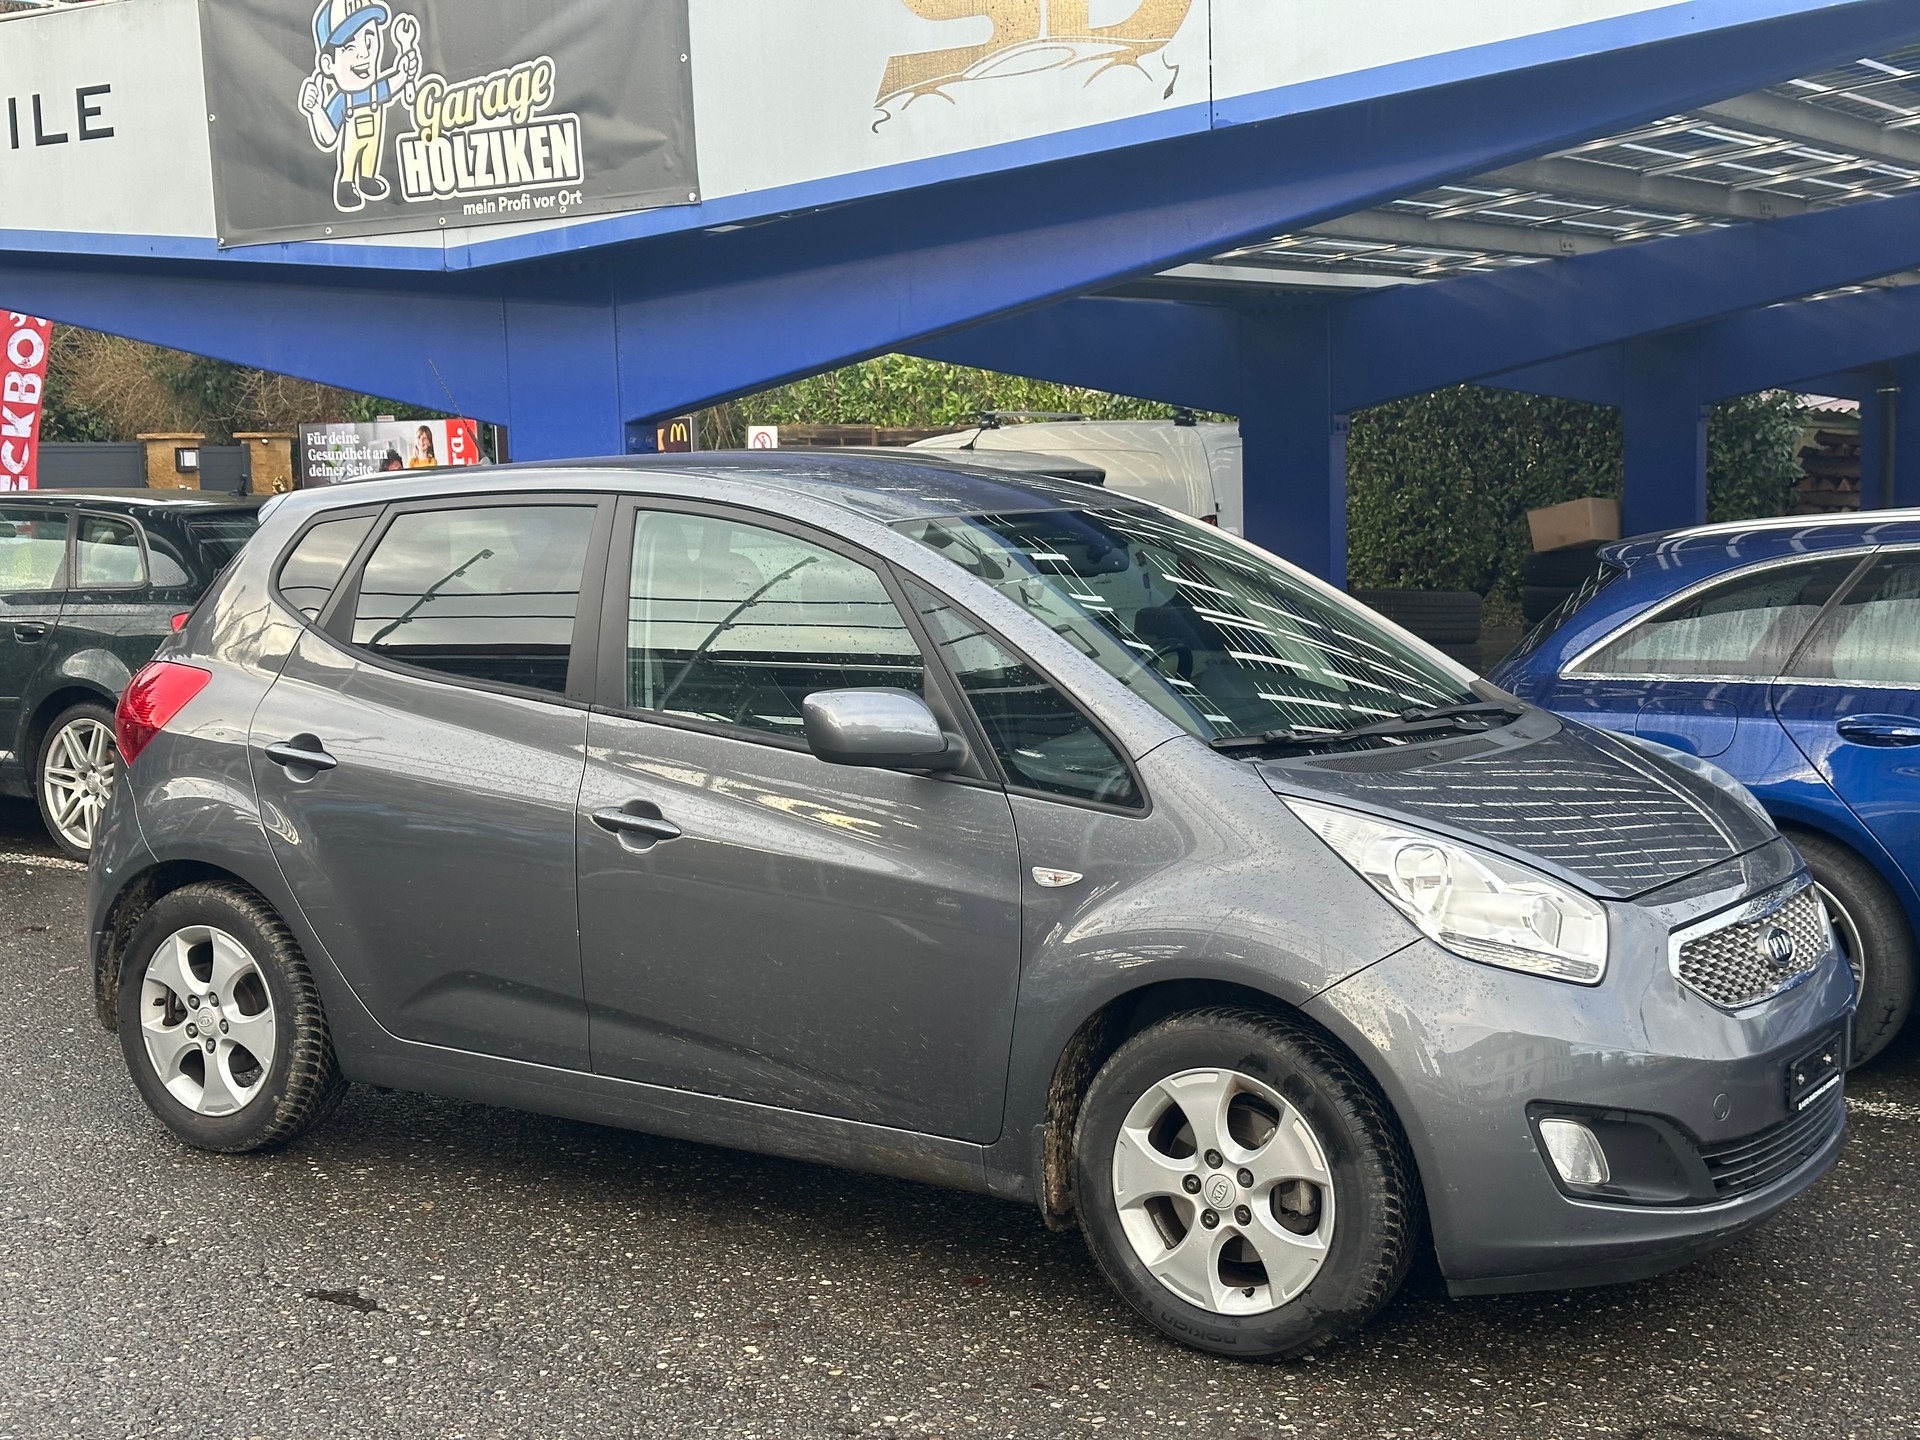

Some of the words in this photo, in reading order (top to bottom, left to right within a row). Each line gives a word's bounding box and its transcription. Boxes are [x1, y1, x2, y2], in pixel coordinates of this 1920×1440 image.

[8, 83, 115, 150] ILE
[415, 64, 550, 146] Garage
[401, 121, 578, 194] HOLZIKEN
[463, 198, 496, 215] mein
[498, 193, 531, 212] Profi
[533, 194, 556, 208] vor
[558, 189, 583, 206] Ort
[306, 432, 327, 446] Für
[329, 431, 360, 445] deine
[307, 446, 372, 461] Gesundheit
[372, 449, 389, 460] an
[308, 463, 346, 477] deiner
[1212, 1183, 1227, 1203] KIA
